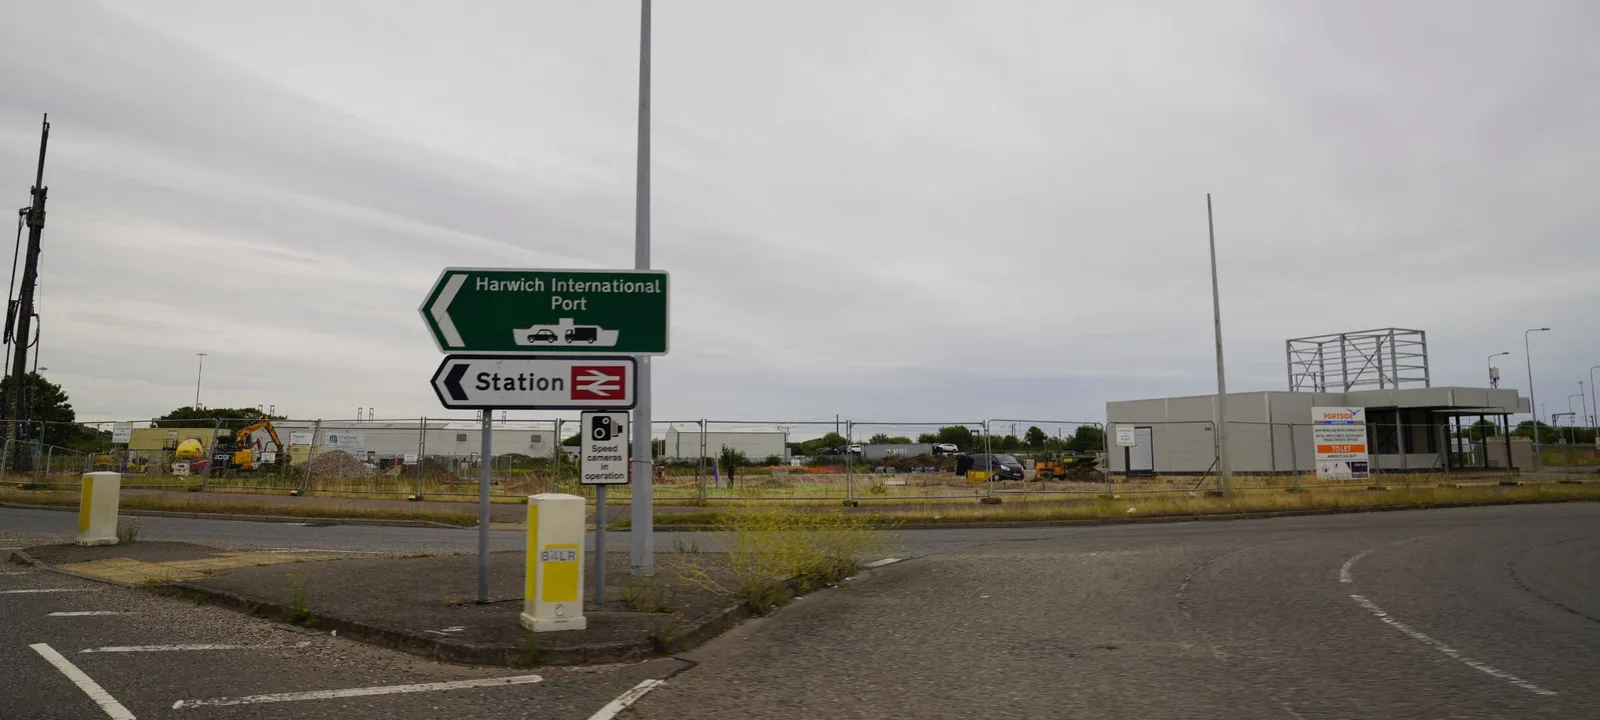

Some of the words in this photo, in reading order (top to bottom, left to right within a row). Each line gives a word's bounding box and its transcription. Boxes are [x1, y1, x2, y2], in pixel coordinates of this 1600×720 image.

[476, 277, 544, 292] Harwich
[551, 277, 661, 293] International
[551, 296, 587, 311] Port
[475, 372, 564, 391] Station
[1323, 412, 1353, 420] PORTSIDE
[591, 444, 618, 454] Speed
[587, 454, 622, 462] cameras
[585, 472, 625, 481] operation
